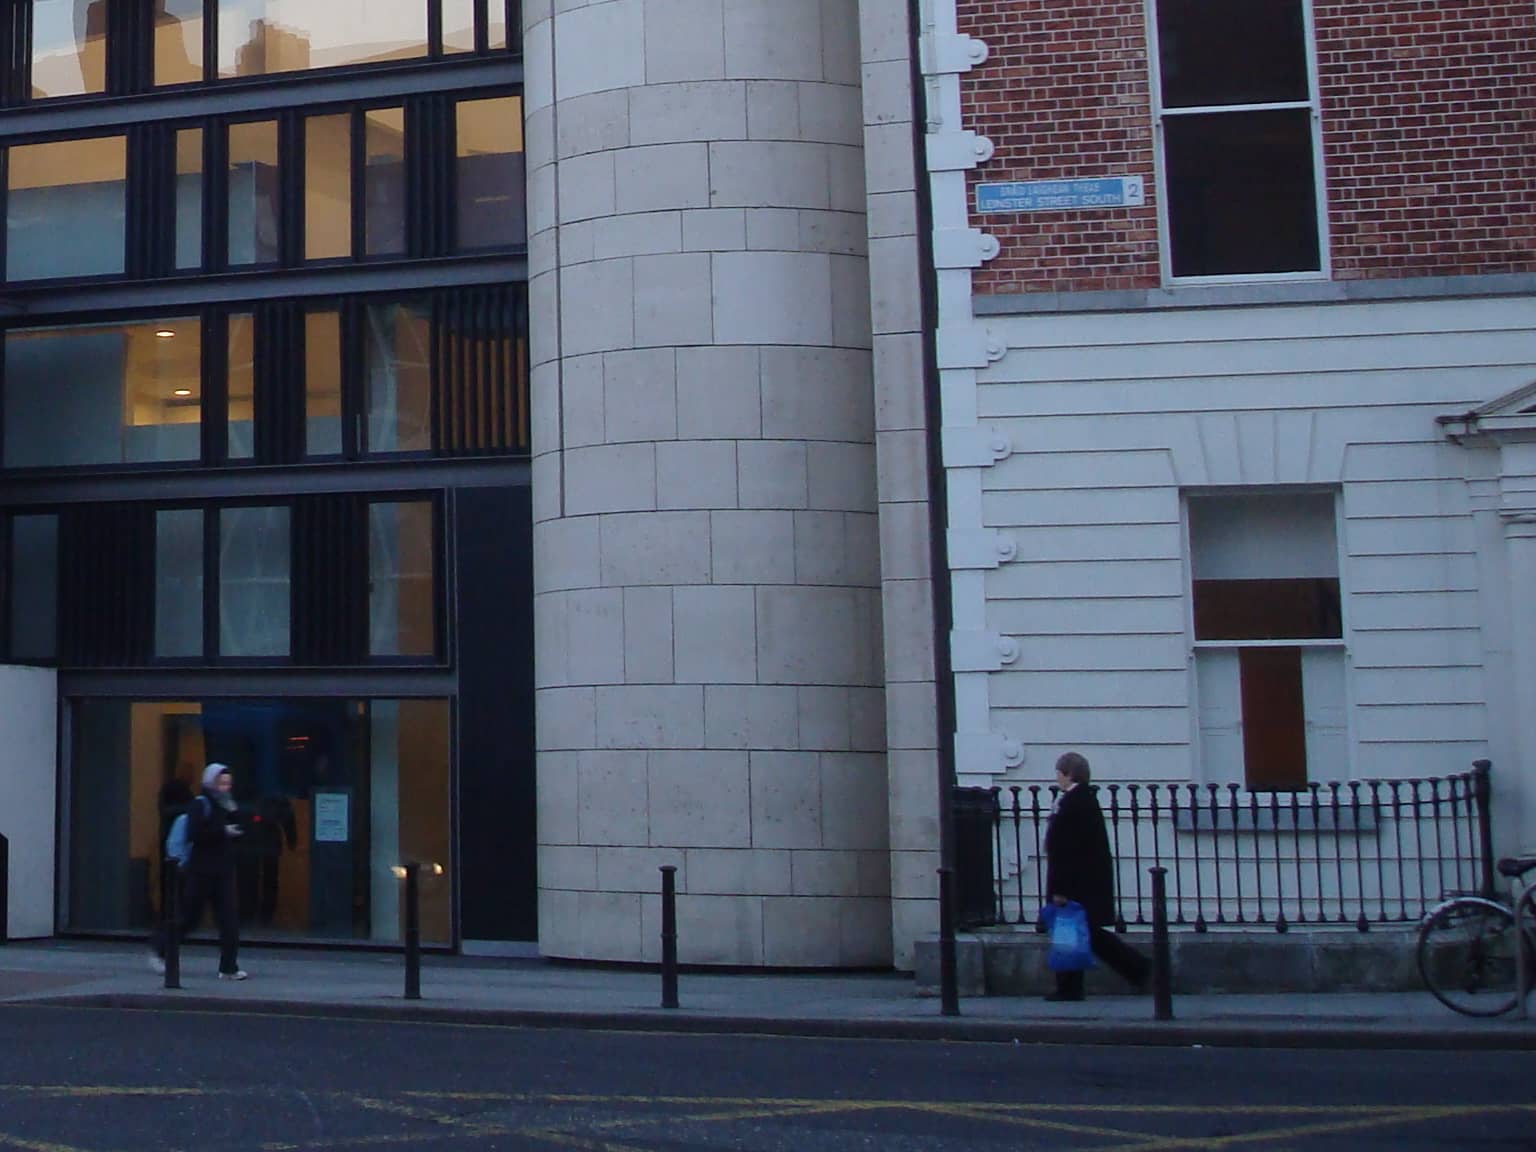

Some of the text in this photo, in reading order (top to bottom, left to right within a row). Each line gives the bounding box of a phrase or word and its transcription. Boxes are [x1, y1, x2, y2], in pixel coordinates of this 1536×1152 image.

[1128, 183, 1139, 197] 2
[981, 193, 1121, 209] LEINSTER STREET SOUTH
